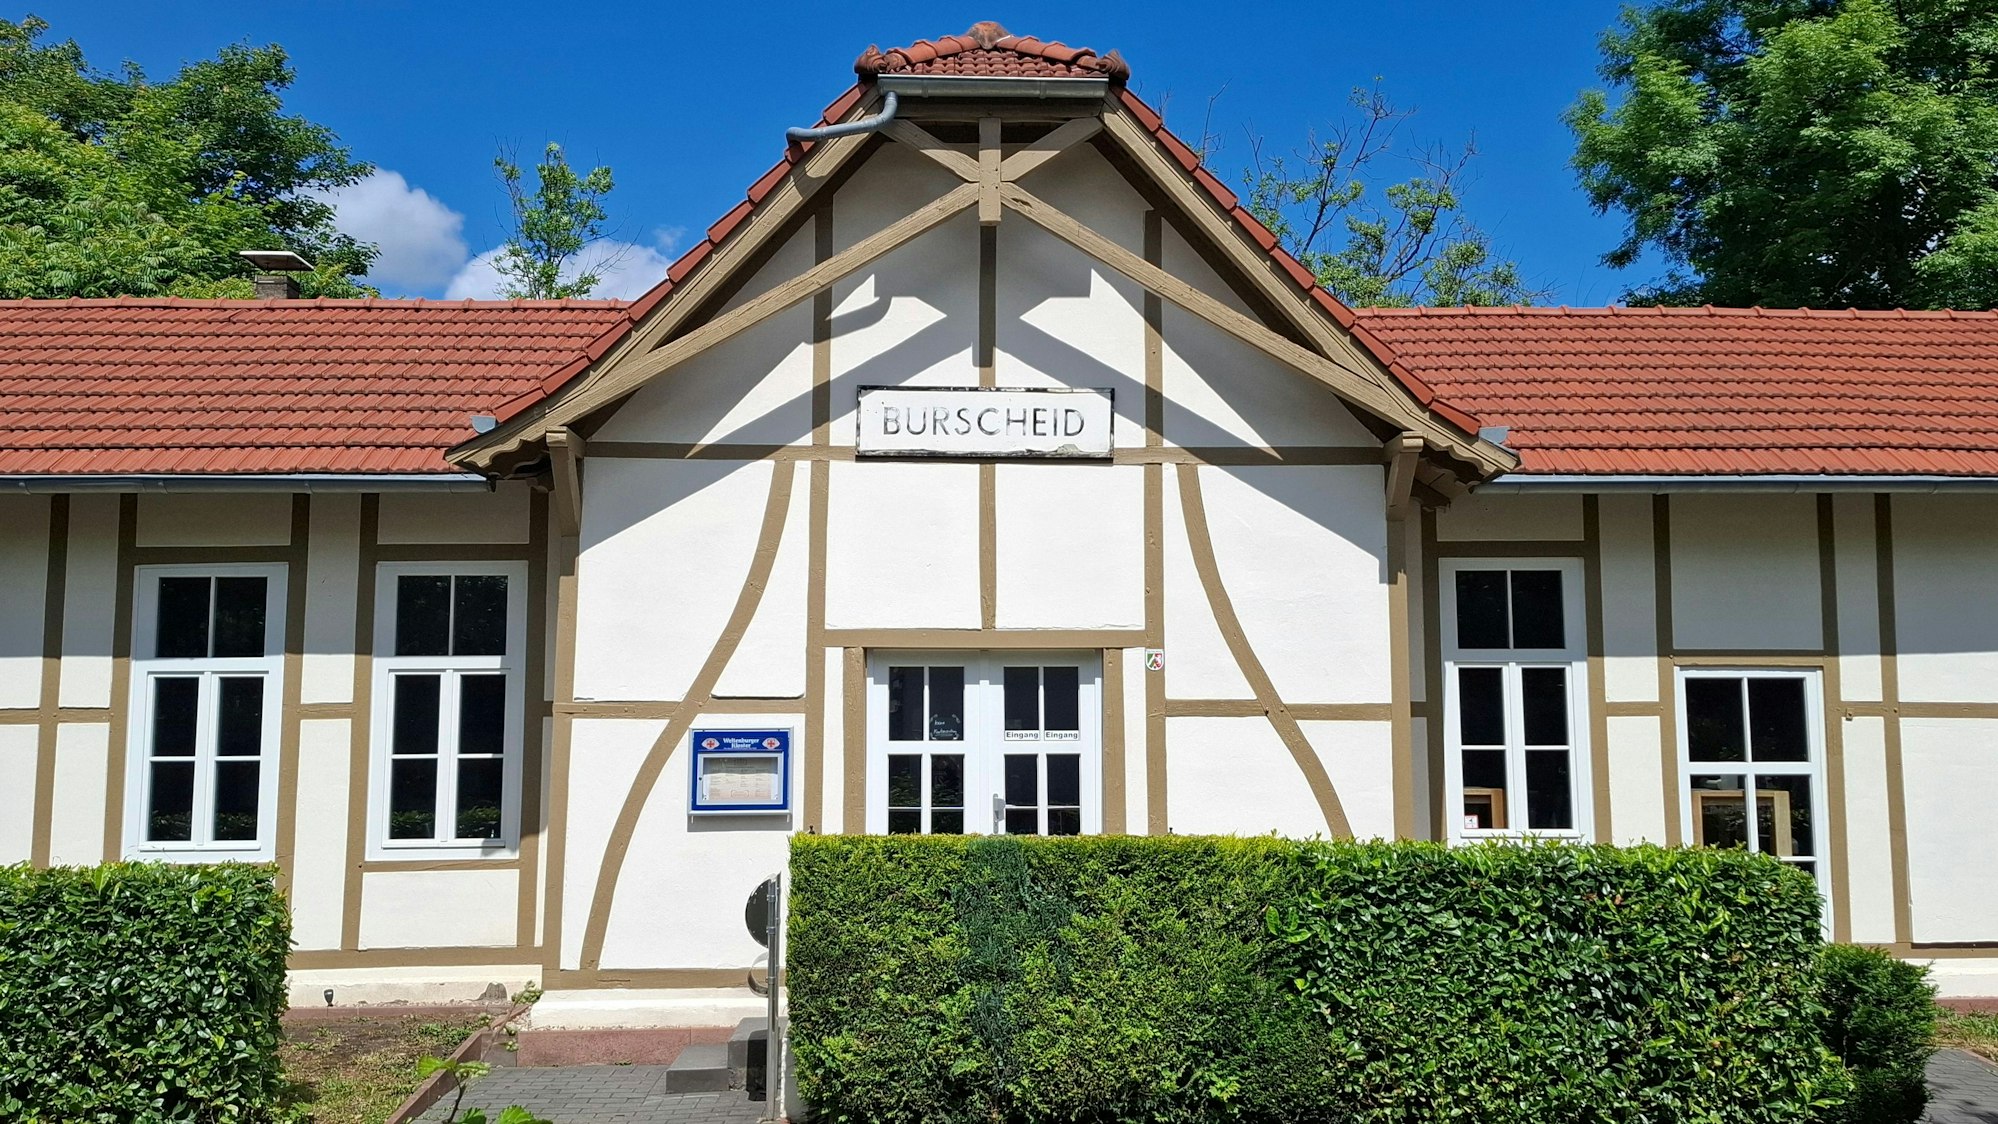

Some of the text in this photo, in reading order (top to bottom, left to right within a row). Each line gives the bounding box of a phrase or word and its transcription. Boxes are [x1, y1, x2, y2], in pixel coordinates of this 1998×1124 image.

[883, 406, 1085, 437] BURSCHEID
[1006, 731, 1039, 739] Eingang
[1045, 731, 1078, 739] Eingang
